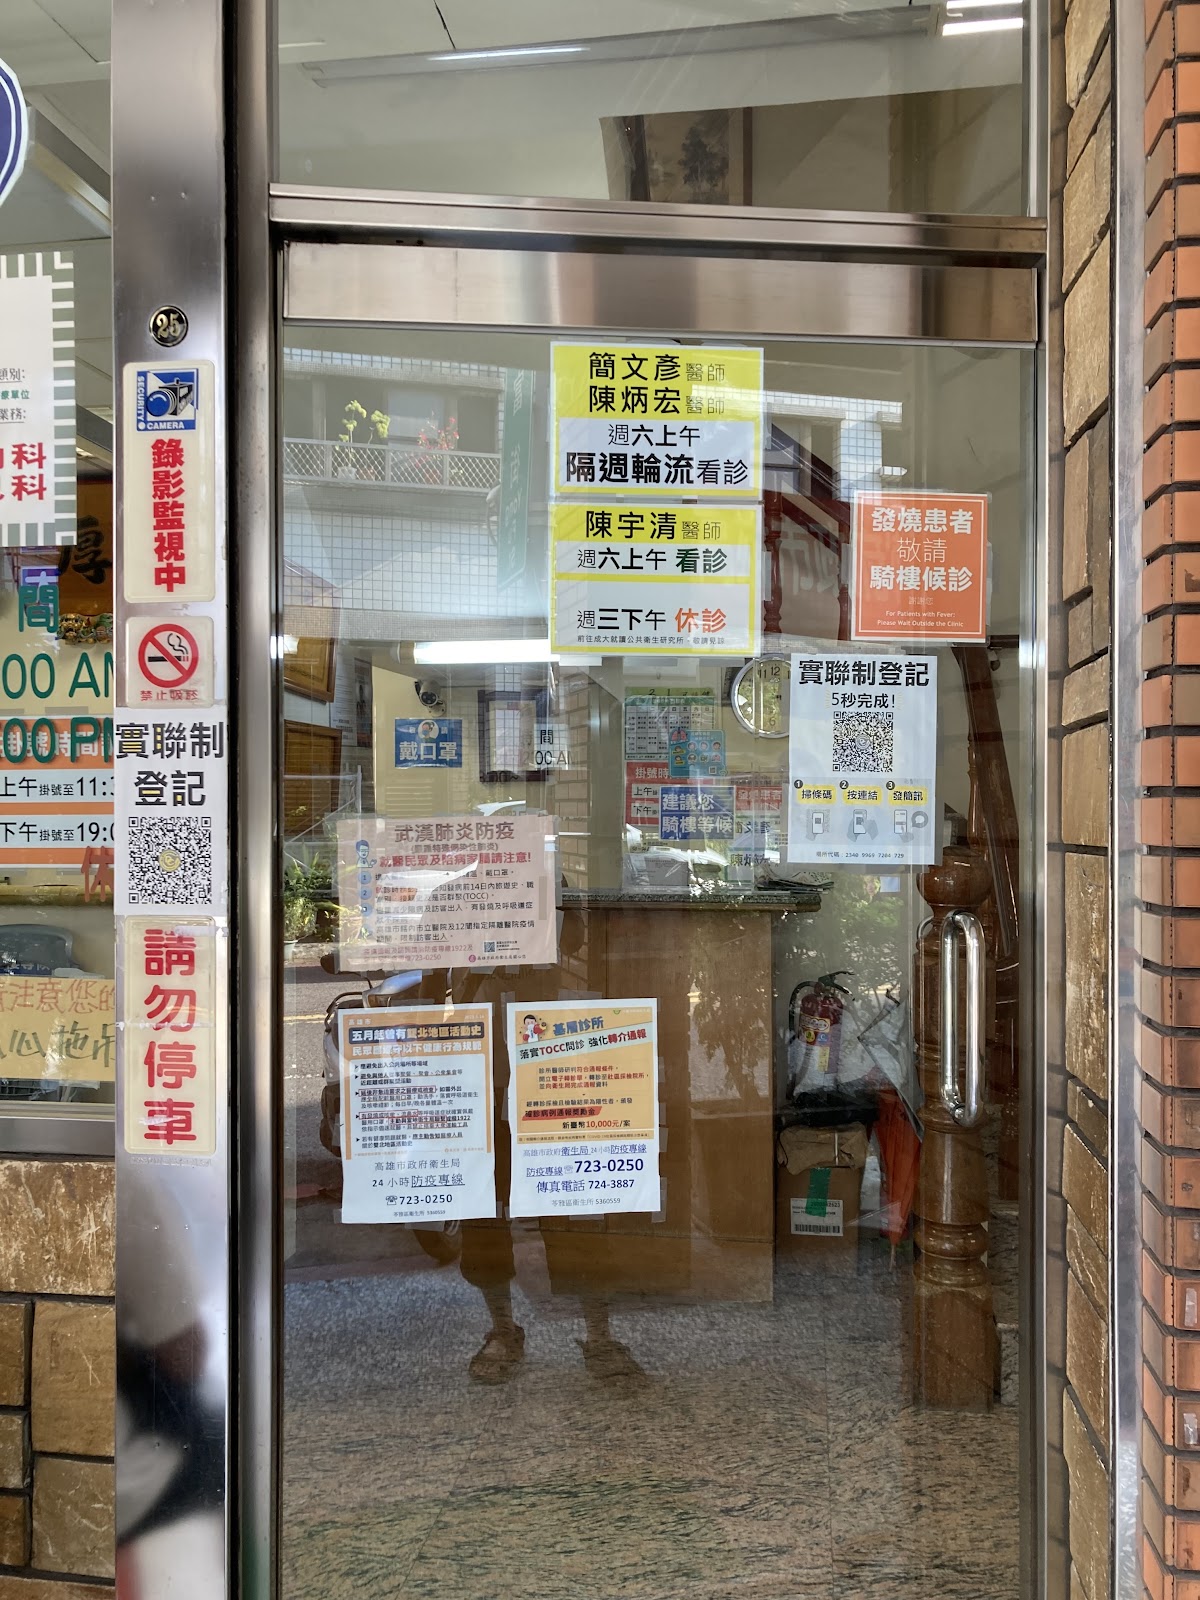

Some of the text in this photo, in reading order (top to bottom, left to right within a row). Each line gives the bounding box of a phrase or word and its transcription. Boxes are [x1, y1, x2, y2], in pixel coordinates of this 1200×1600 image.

[156, 312, 181, 339] 25
[137, 375, 146, 421] SECURITY
[147, 421, 185, 430] CAMERA
[607, 424, 701, 447] 週六上午
[566, 451, 748, 485] 隔週輪流看診
[0, 473, 47, 502] 科
[151, 438, 186, 592] 錄影監視中
[586, 510, 721, 541] 陳宇清醫師
[872, 507, 973, 535] 發燒患者
[577, 547, 727, 574] 週六上午 看診
[897, 537, 948, 563] 敬請
[870, 565, 973, 592] 騎樓候診
[19, 585, 59, 633] 間
[577, 607, 727, 633] 週三下午 休診
[897, 610, 921, 618] Patients
[922, 610, 935, 618] with
[947, 620, 964, 628] Clinic
[798, 660, 930, 687] 實聯制登記
[831, 692, 896, 709] 5秒完成!
[115, 721, 225, 760] 實聯制
[399, 741, 457, 761] 戴口罩
[635, 766, 672, 781] 掛號時
[134, 770, 206, 807] 登記
[801, 789, 832, 800] 掃條碼
[847, 790, 878, 801] 按連結
[662, 793, 714, 811] 建議您
[394, 821, 514, 842] 武漢肺炎防疫
[661, 816, 733, 834] 騎樓等候
[144, 929, 197, 1145] 請勿停車
[553, 1016, 604, 1036] 基層診所
[374, 1158, 461, 1171] 高雄市政府衛生局
[574, 1158, 644, 1173] 723-0250
[537, 1179, 635, 1193] 傳真電話 724-3887
[399, 1193, 453, 1205] 723-0250
